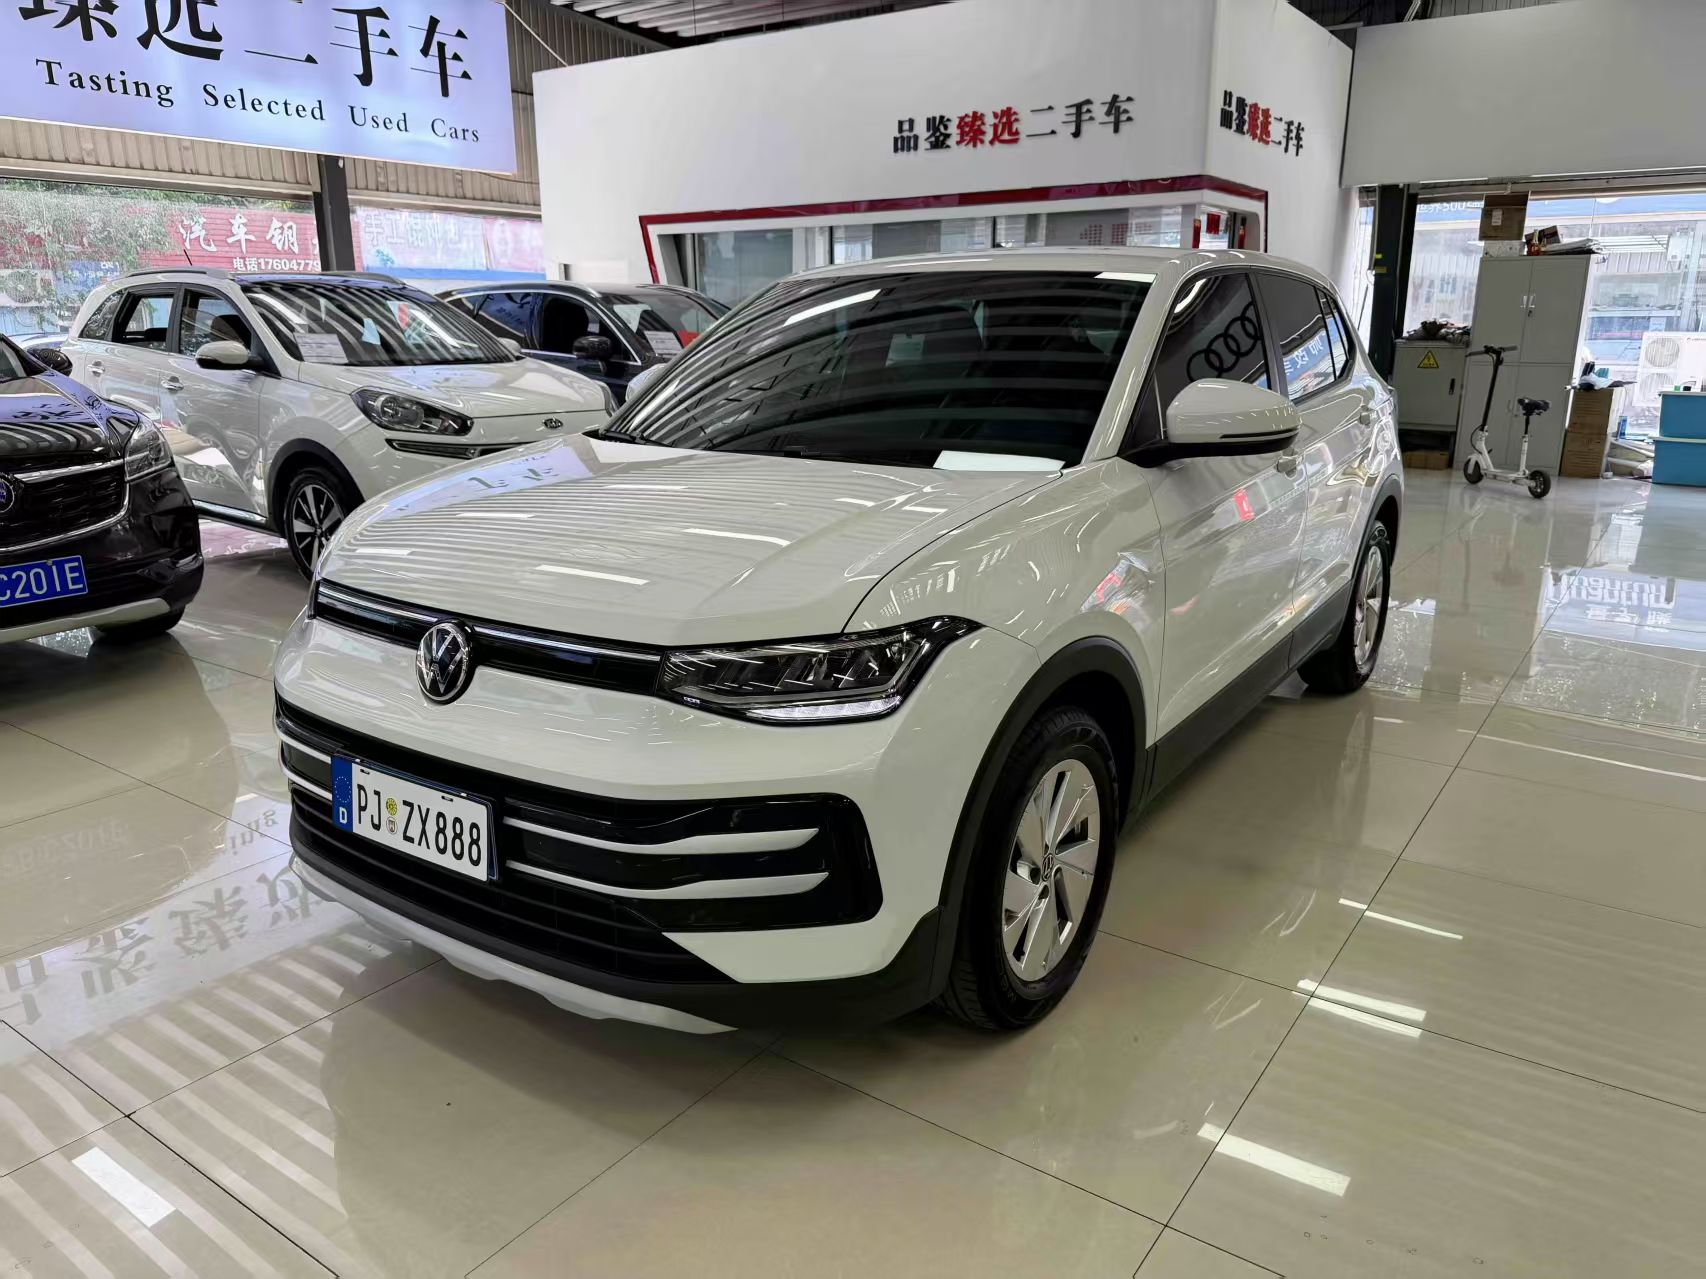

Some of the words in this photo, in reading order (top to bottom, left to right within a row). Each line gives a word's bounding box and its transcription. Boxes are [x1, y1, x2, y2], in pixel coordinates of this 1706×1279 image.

[35, 58, 174, 107] Tasting
[203, 84, 326, 122] Selected
[347, 104, 411, 134] Used
[430, 117, 481, 143] Cars
[892, 93, 1136, 154] 品鉴臻选二手车
[1219, 89, 1304, 157] 品鉴臻选二手车
[178, 212, 321, 255] 汽车钥
[356, 783, 382, 831] PJ
[402, 799, 482, 867] ZX888
